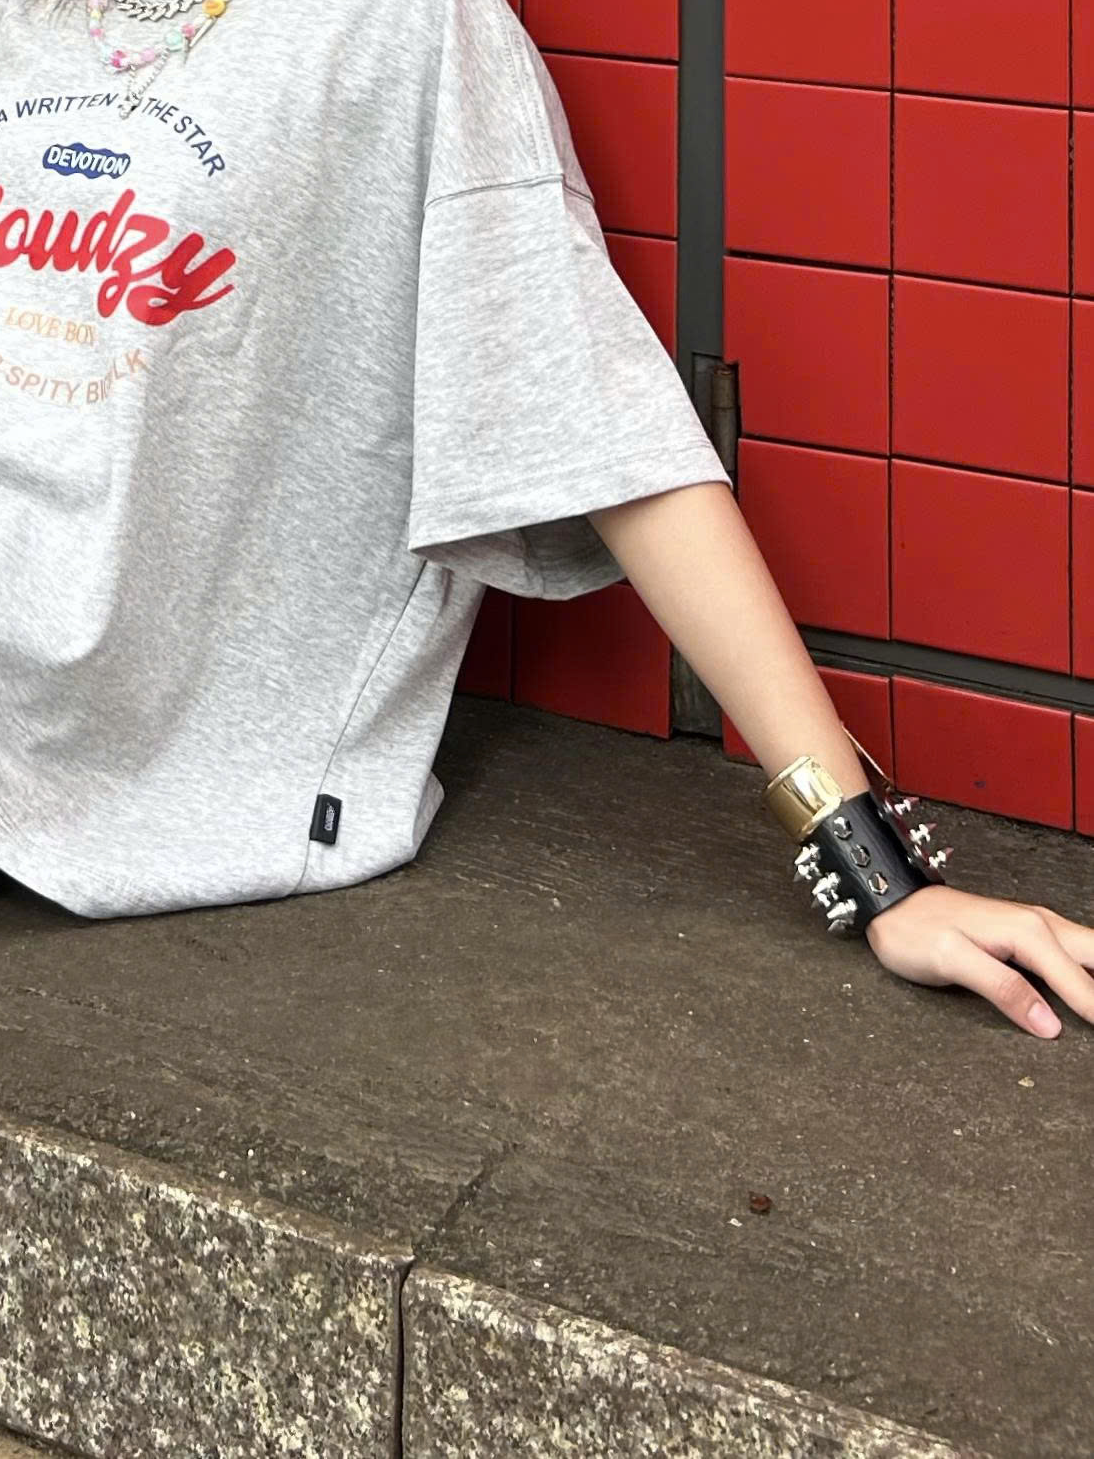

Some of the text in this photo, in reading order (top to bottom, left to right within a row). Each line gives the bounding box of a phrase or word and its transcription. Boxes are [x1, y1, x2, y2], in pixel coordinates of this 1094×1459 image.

[14, 93, 119, 118] WRITTEN
[141, 97, 180, 124] THE
[173, 115, 226, 177] STAR
[47, 145, 129, 175] DEVOTION
[6, 307, 61, 338] LOVE
[6, 366, 82, 404] SPITY
